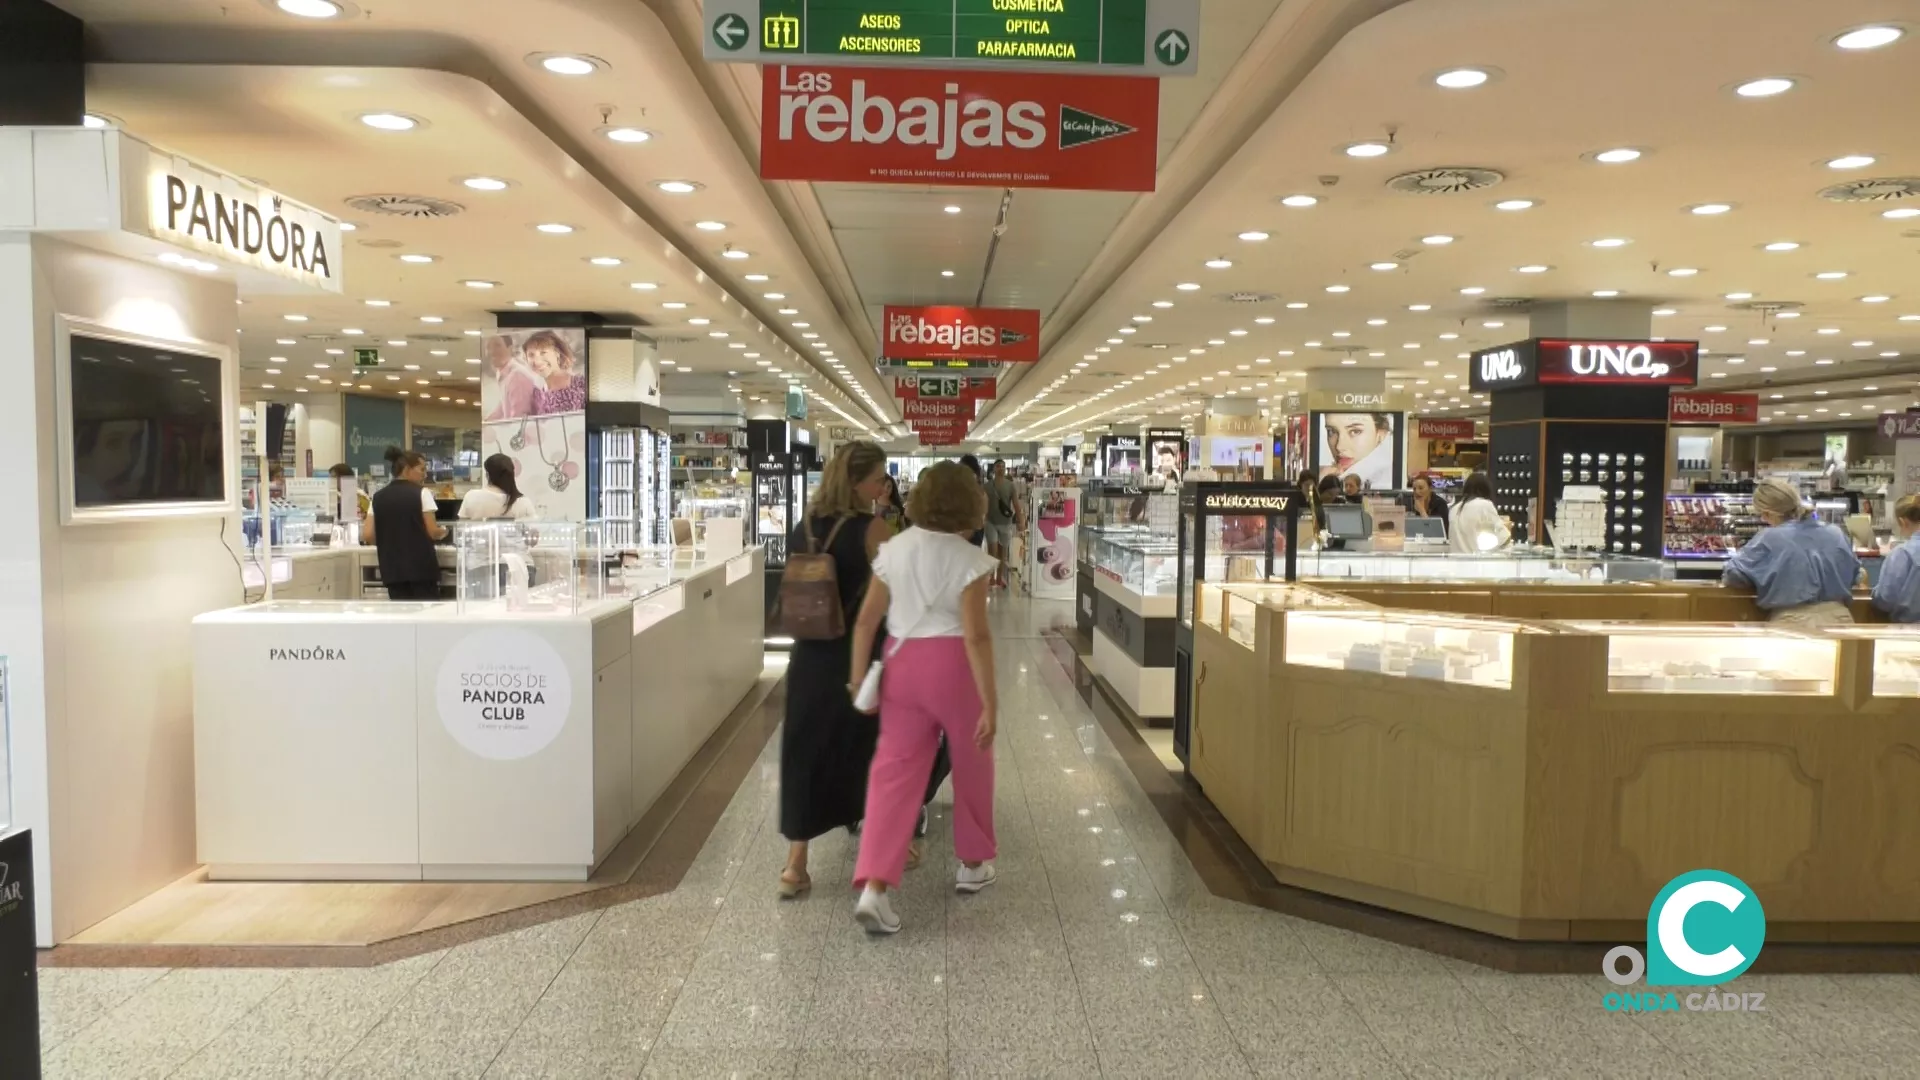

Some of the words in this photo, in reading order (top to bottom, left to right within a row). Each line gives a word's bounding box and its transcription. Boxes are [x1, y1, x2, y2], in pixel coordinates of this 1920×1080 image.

[860, 15, 901, 29] ASEOS
[1006, 19, 1049, 34] OPTICA
[840, 37, 921, 52] ASCENSORES
[978, 41, 1076, 58] PARAFARMACIA
[780, 65, 832, 92] Las
[779, 79, 1046, 160] rebajas
[878, 168, 888, 176] NO
[914, 170, 955, 178] SATISFECHO
[966, 171, 1012, 180] DEVOLVEMOS
[167, 175, 331, 278] PANDORA
[890, 317, 996, 350] rebajas
[1673, 399, 1733, 418] rebajas
[270, 645, 346, 660] PANDORA
[461, 673, 522, 688] SOCIOS
[527, 673, 547, 688] DE
[462, 689, 545, 704] PANDORA
[482, 707, 525, 720] CLUB
